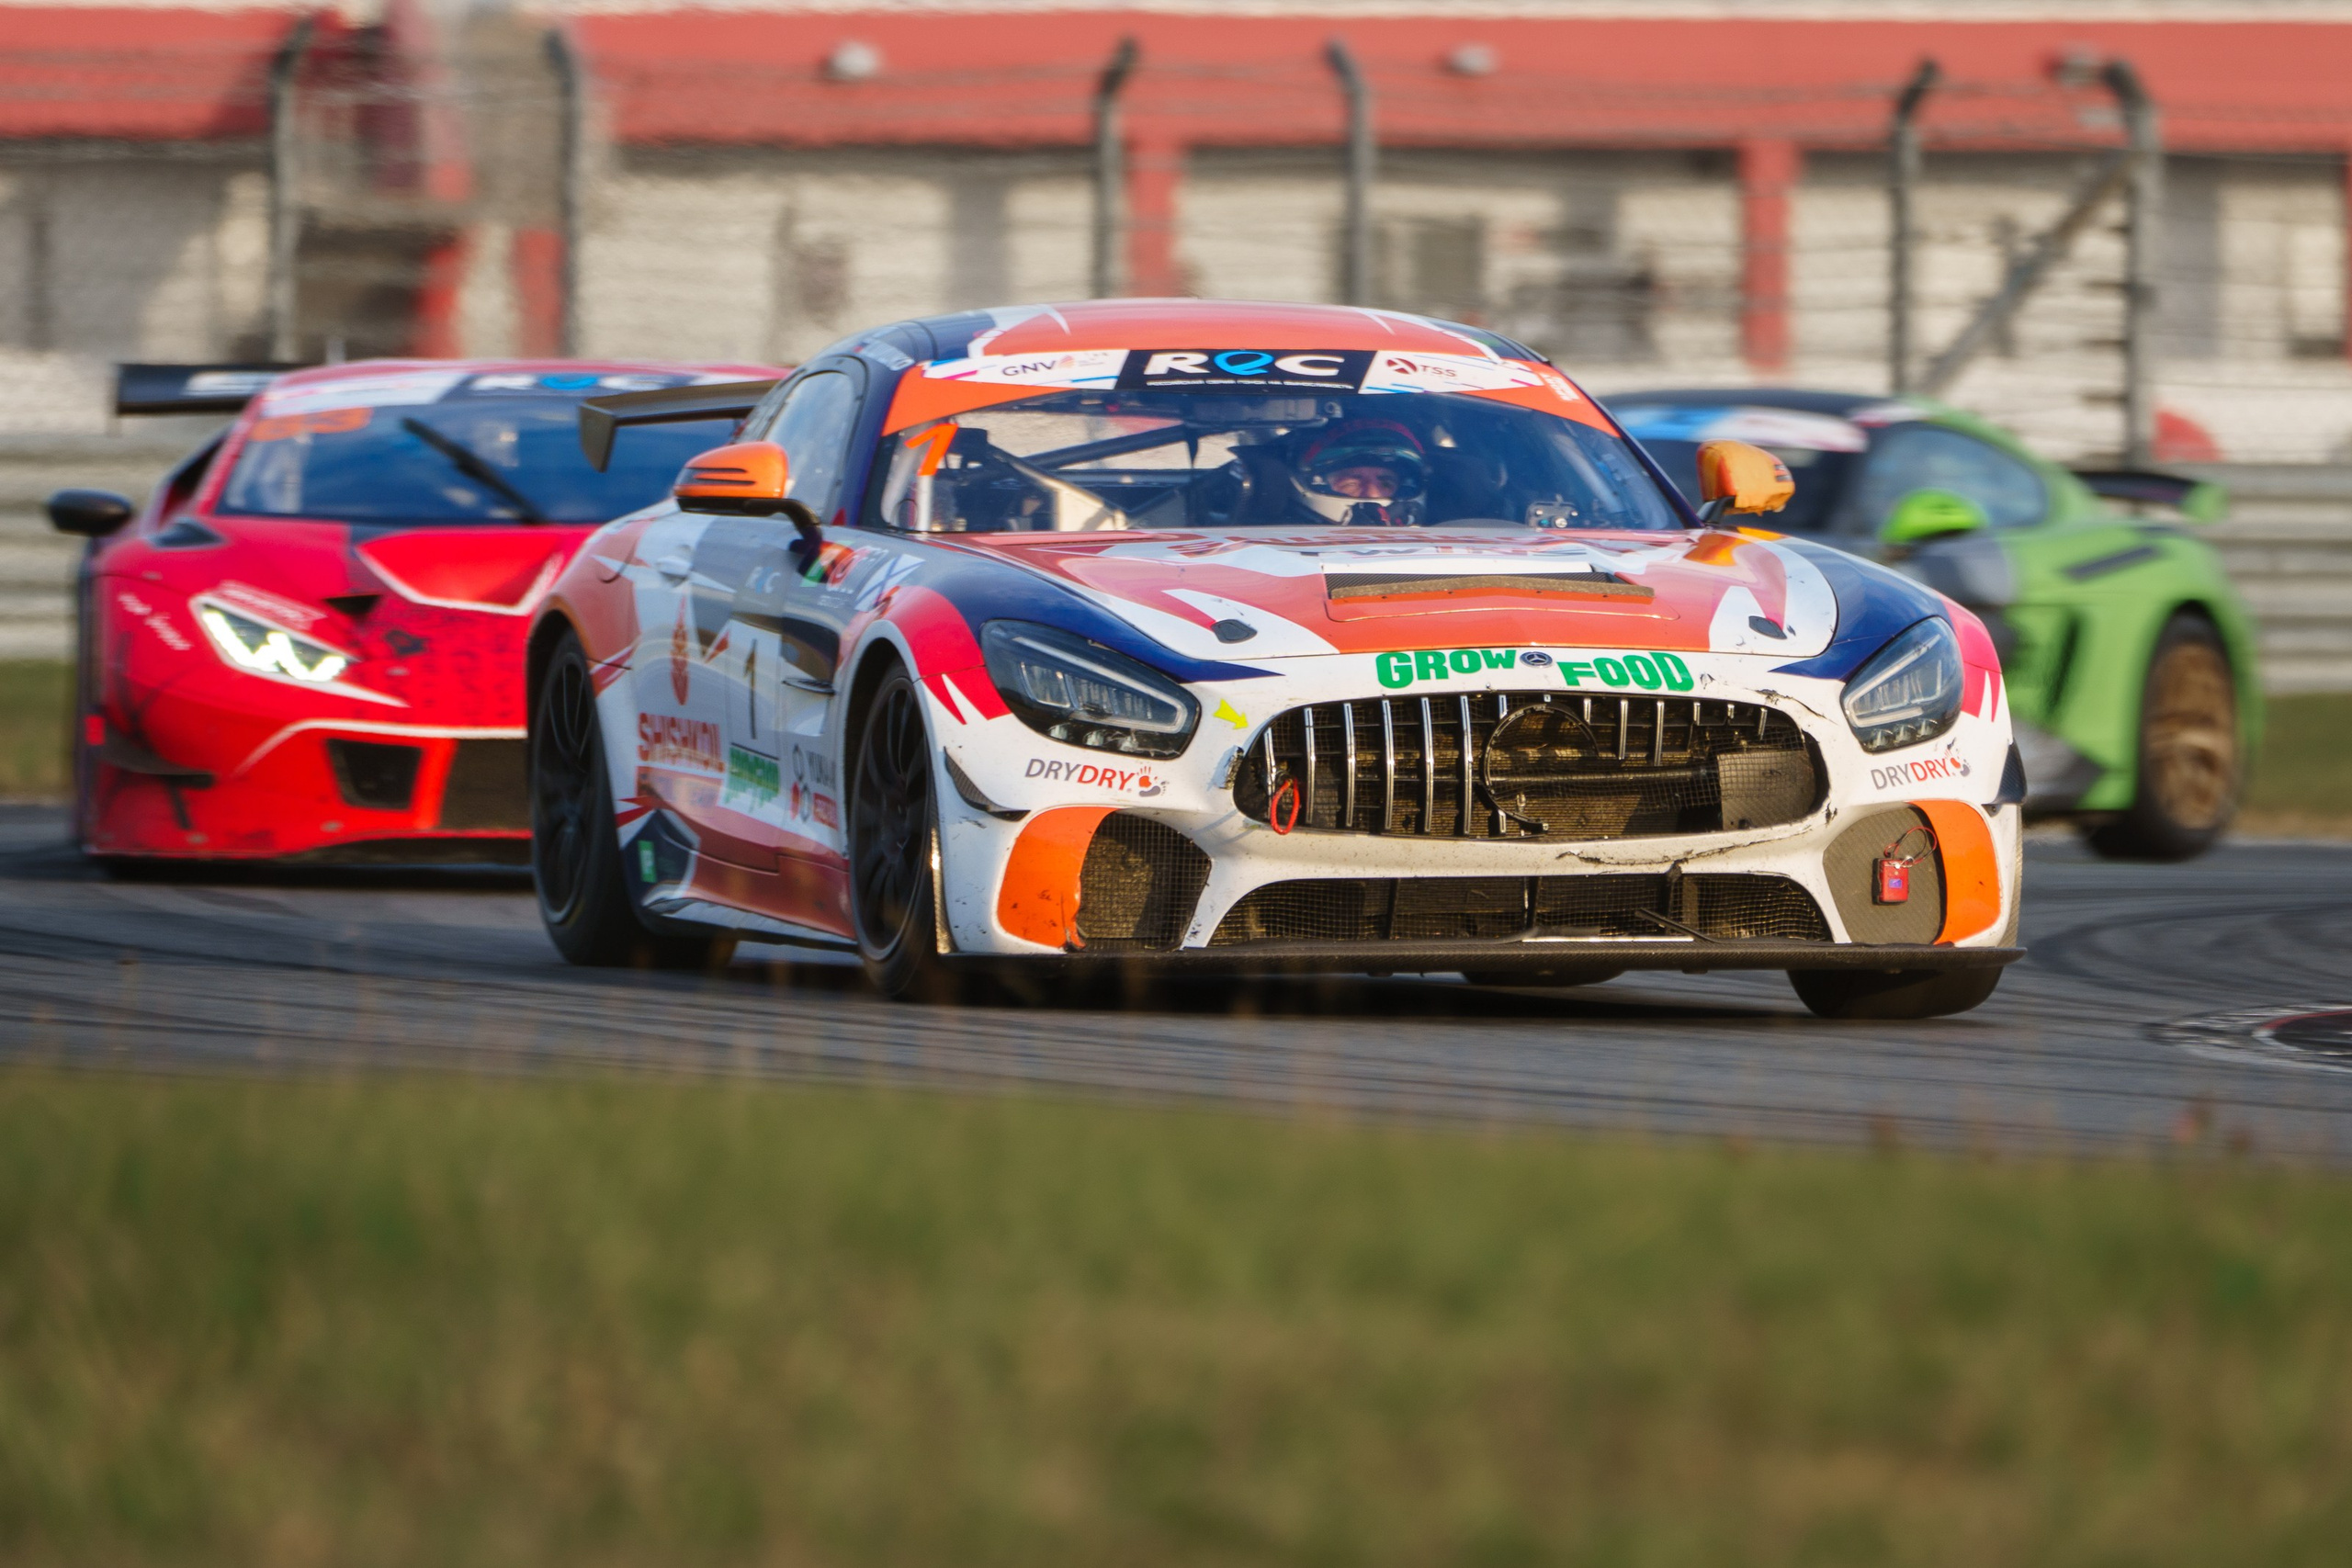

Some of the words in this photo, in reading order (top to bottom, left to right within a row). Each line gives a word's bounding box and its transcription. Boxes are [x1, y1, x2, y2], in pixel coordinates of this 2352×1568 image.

[1001, 360, 1056, 377] GNV
[1420, 365, 1456, 378] TSS
[904, 423, 959, 476] 1
[1376, 649, 1516, 689] GROW
[1556, 652, 1694, 692] FOOD
[743, 638, 757, 739] 1
[1024, 758, 1136, 791] DRYDRY
[1871, 759, 1951, 791] DRYDRY
